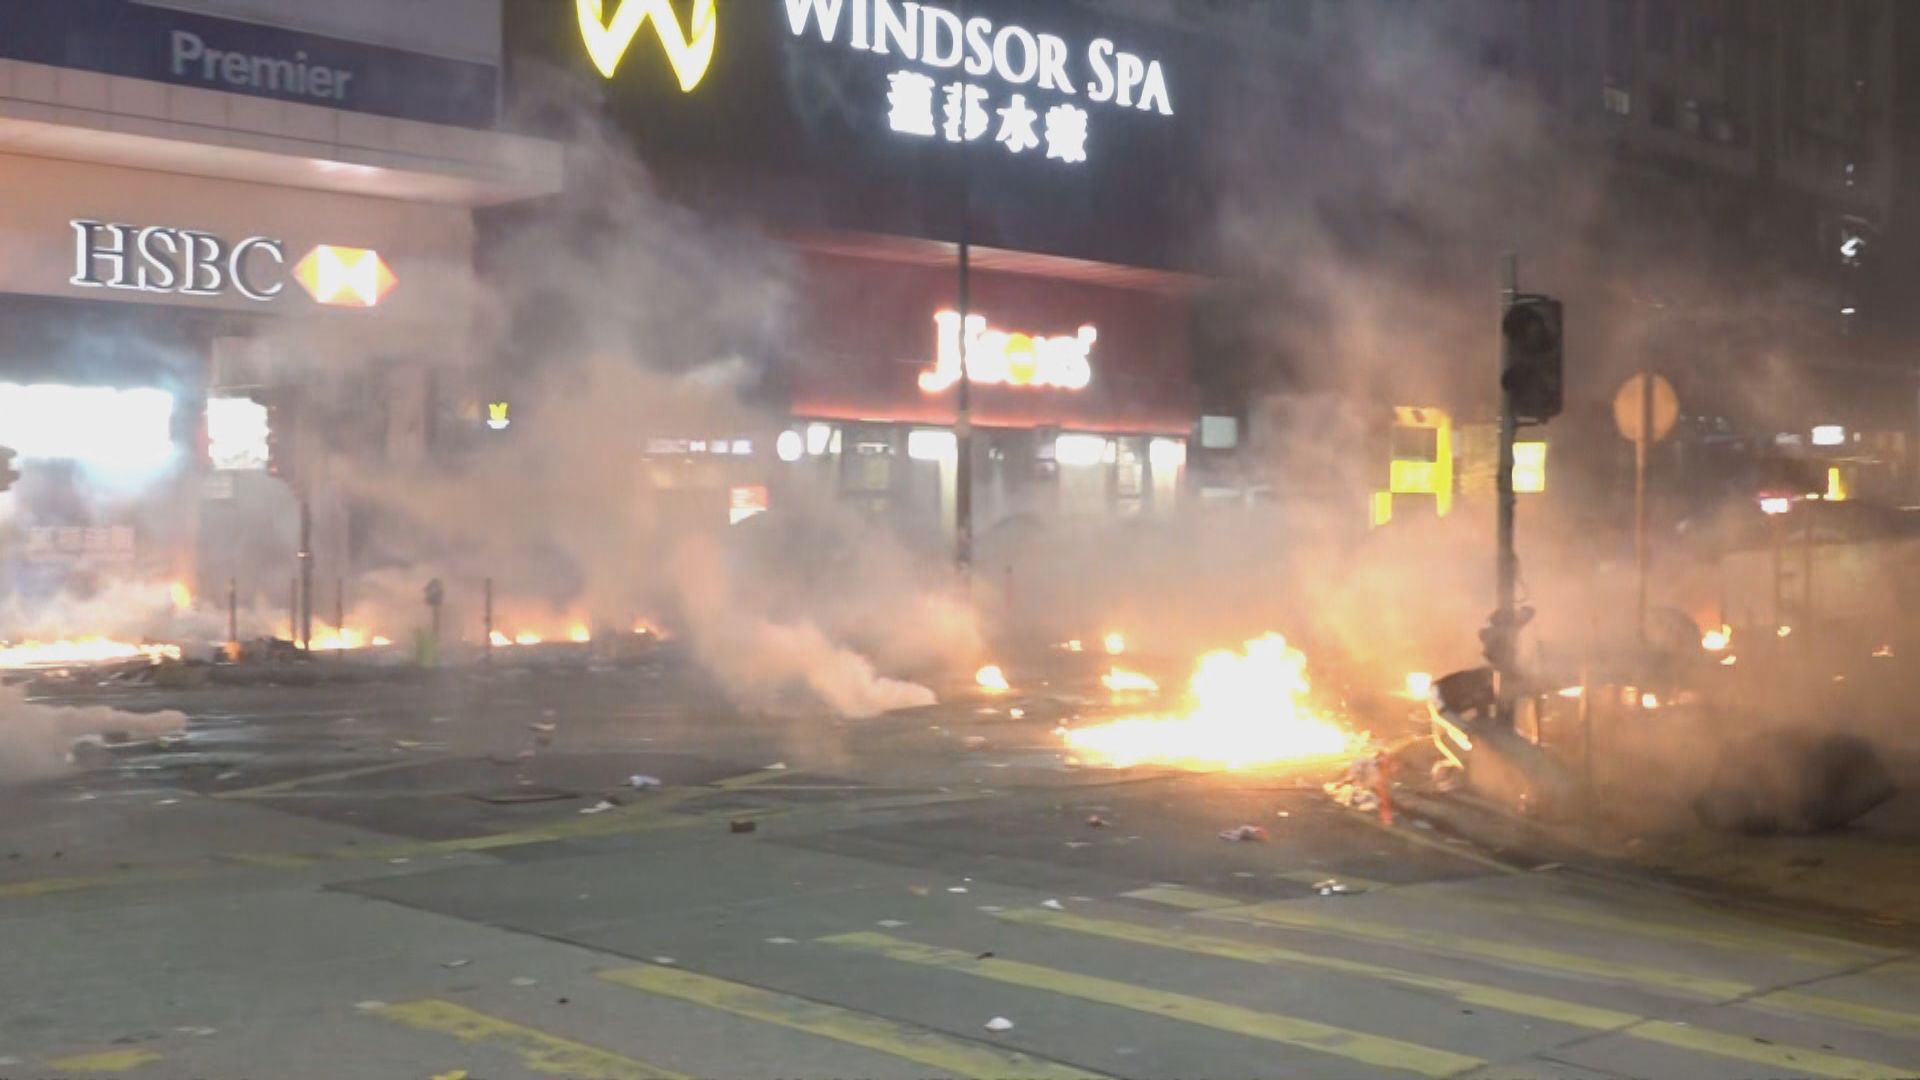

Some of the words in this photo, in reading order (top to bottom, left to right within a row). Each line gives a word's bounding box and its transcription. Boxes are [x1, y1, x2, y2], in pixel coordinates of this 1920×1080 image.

[170, 29, 353, 99] Premier
[776, 0, 1076, 94] WINDSOR
[69, 219, 284, 300] HSBC
